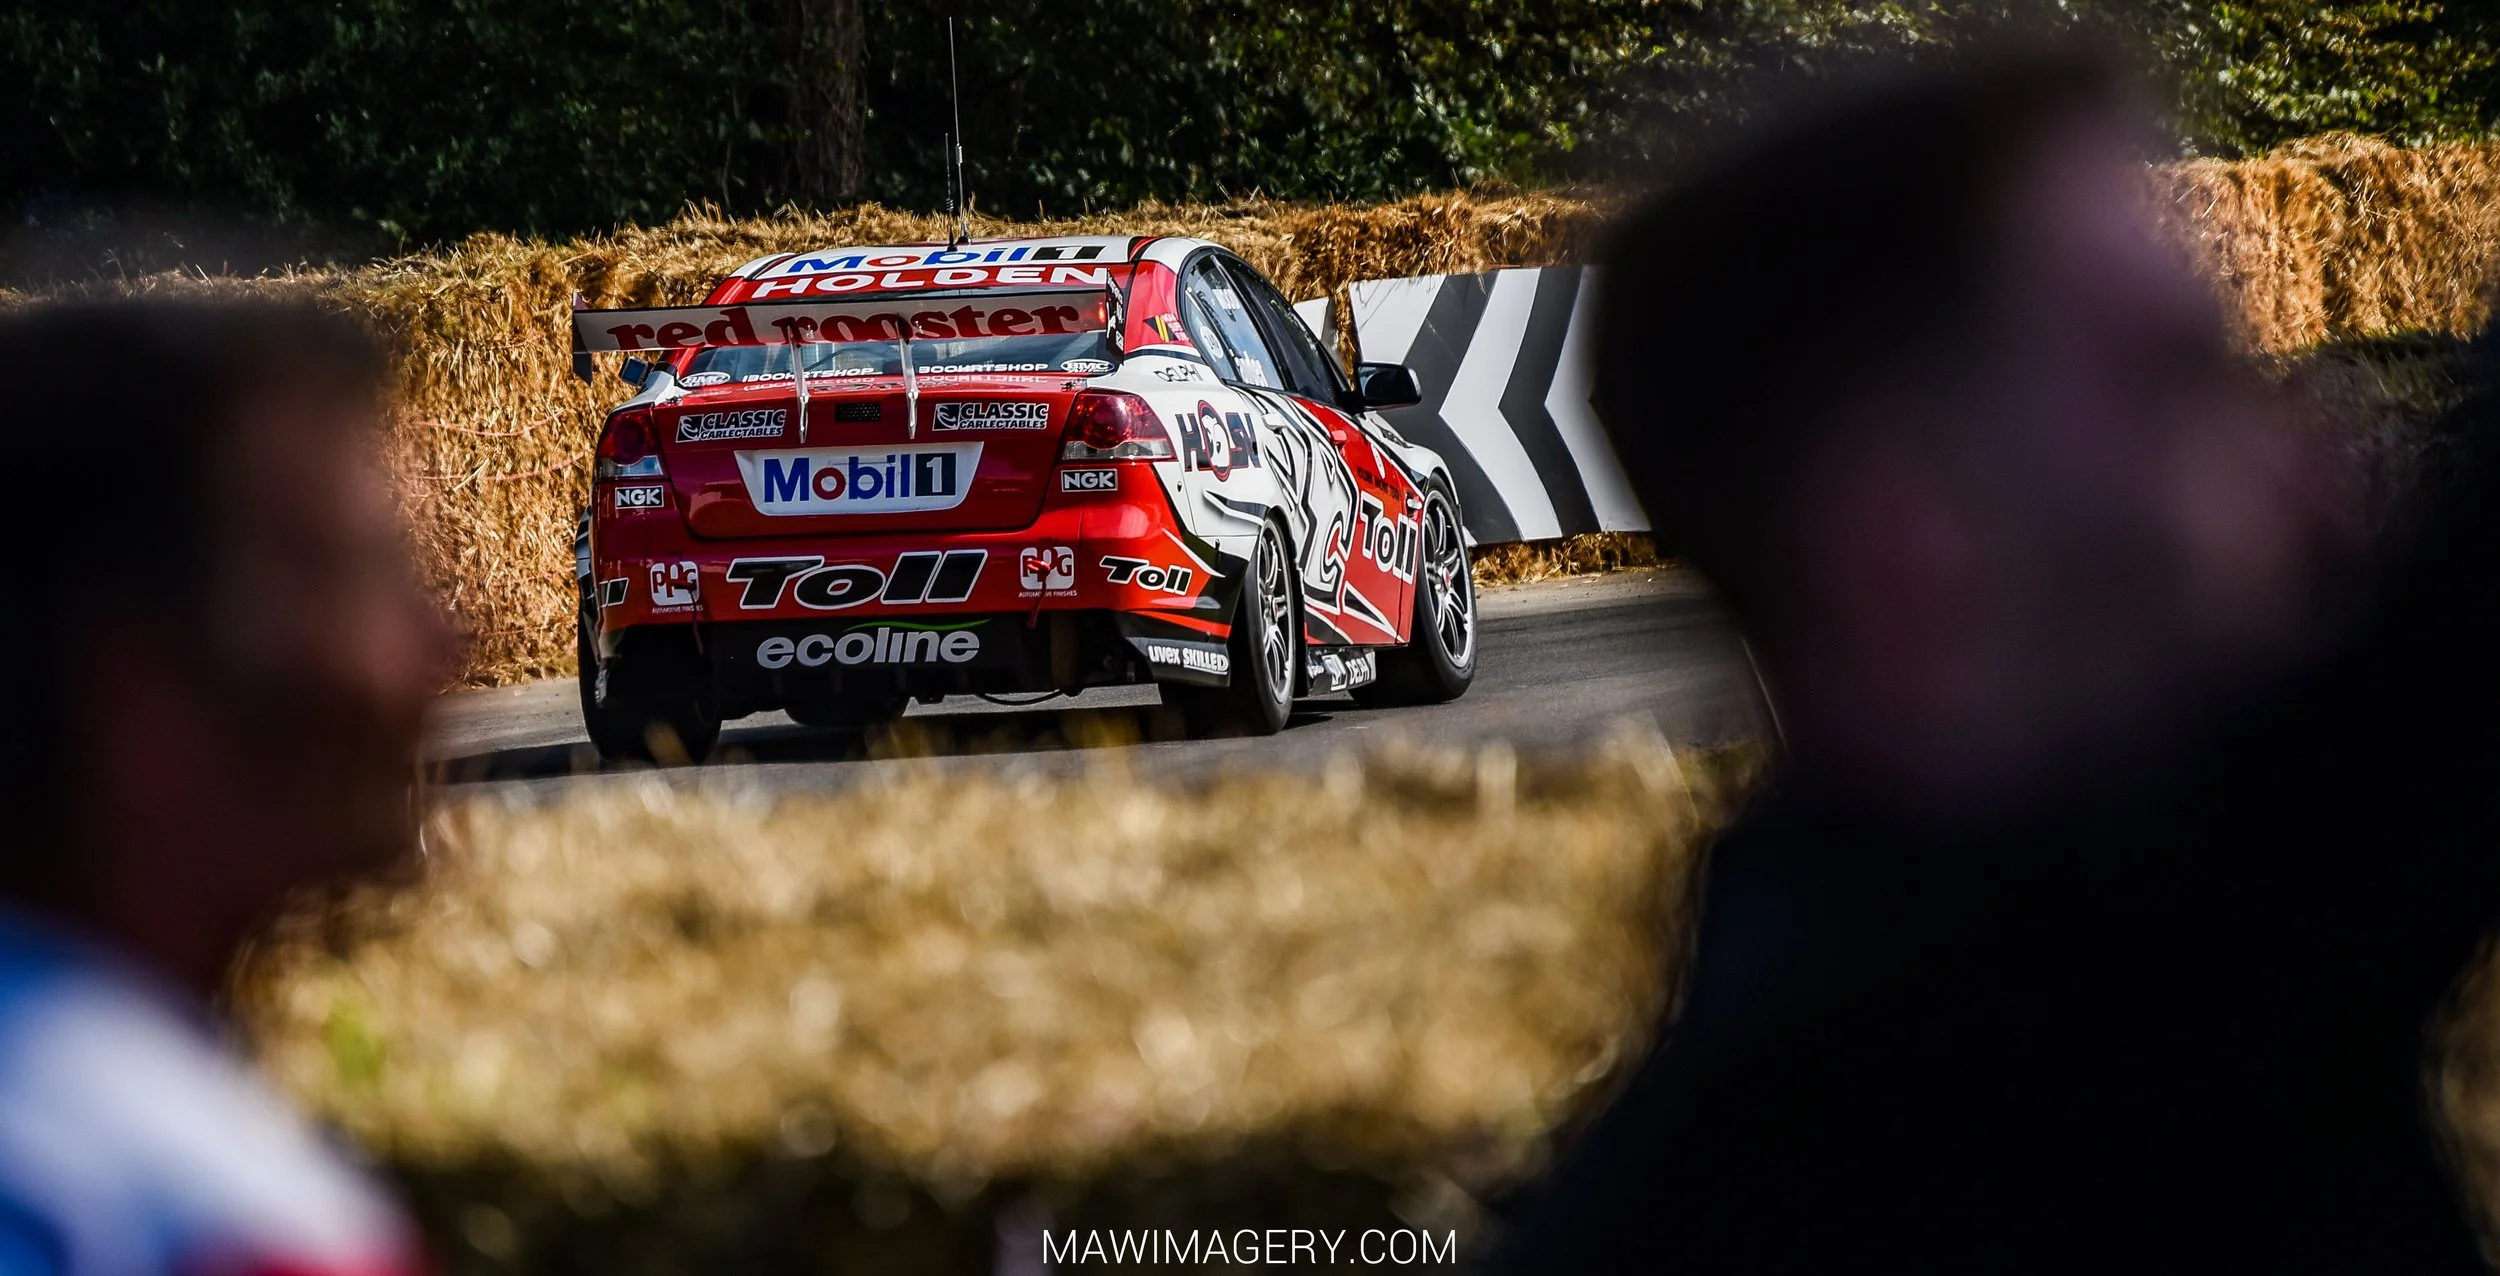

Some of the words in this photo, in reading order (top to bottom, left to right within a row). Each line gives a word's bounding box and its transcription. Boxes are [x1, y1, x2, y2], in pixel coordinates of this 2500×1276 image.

[752, 267, 1108, 299] HOLDEN
[607, 307, 766, 350] red
[771, 304, 1079, 343] rooster
[703, 410, 787, 428] CLASSIC
[961, 403, 1048, 419] CLASSIC
[701, 427, 783, 439] CARLECTABLES
[960, 419, 1046, 429] CARLECTABLES
[1063, 471, 1115, 489] NGK
[617, 489, 660, 506] NGK
[1360, 490, 1419, 585] Toll
[726, 550, 988, 610] Toll
[1100, 555, 1192, 596] Toll
[757, 627, 980, 669] ecoline
[1182, 648, 1229, 673] SKILLED
